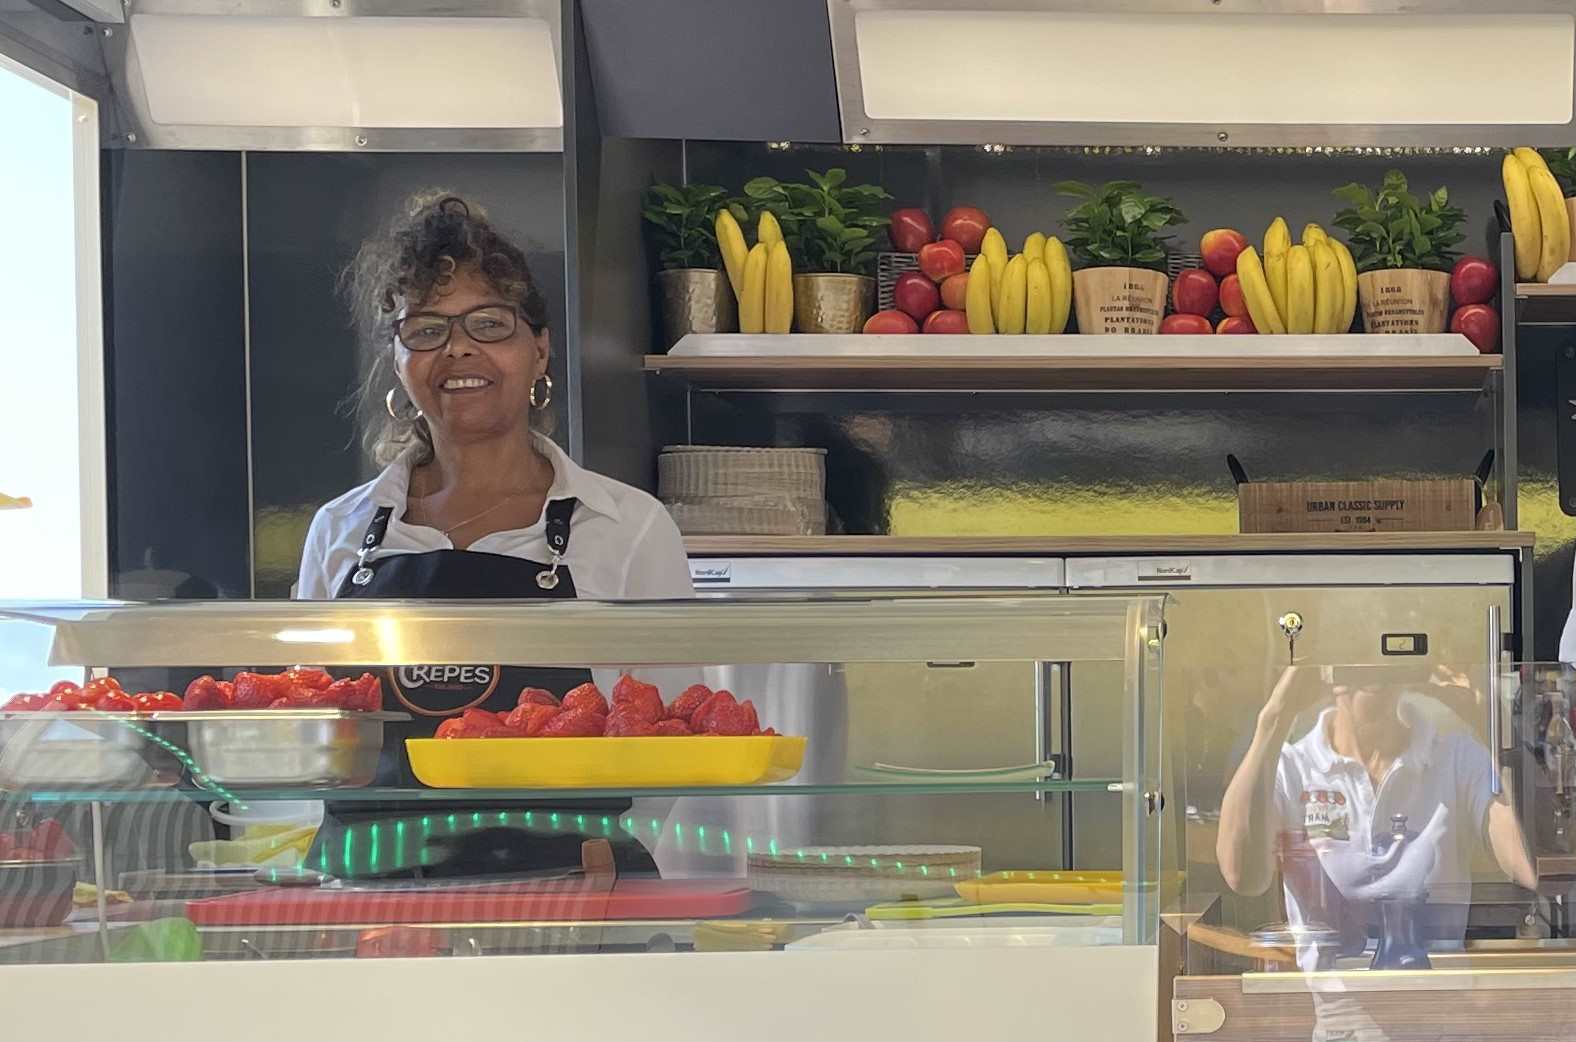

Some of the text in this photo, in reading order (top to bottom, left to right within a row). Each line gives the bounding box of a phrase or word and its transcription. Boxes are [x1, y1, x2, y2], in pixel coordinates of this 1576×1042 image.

[1306, 500, 1405, 512] URBAN CLASSIC SUPPLY
